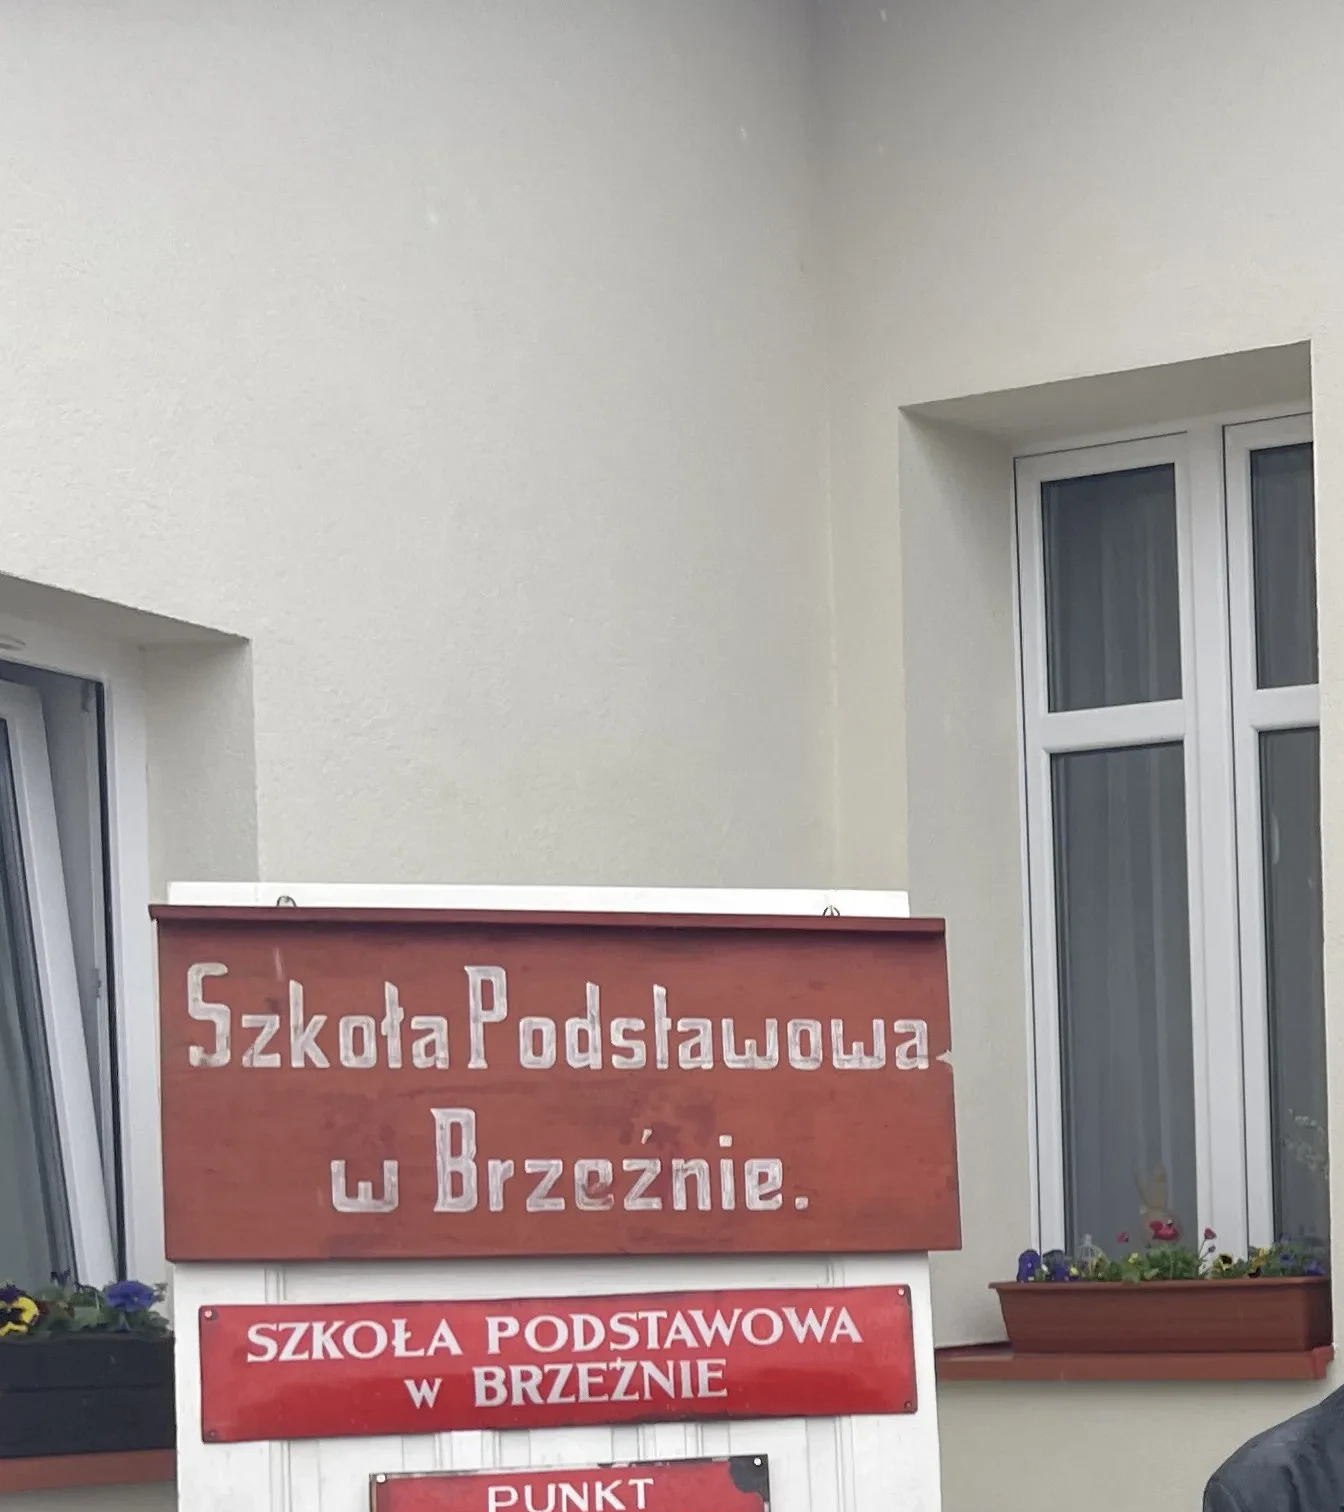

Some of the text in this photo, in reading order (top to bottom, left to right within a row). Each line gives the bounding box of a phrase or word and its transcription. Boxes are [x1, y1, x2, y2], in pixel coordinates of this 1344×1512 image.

[187, 962, 929, 1070] Szkoła Podstawowa
[330, 1107, 809, 1213] w Brzeźnie.
[246, 1306, 864, 1363] SZKOŁA PODSTAWOWA
